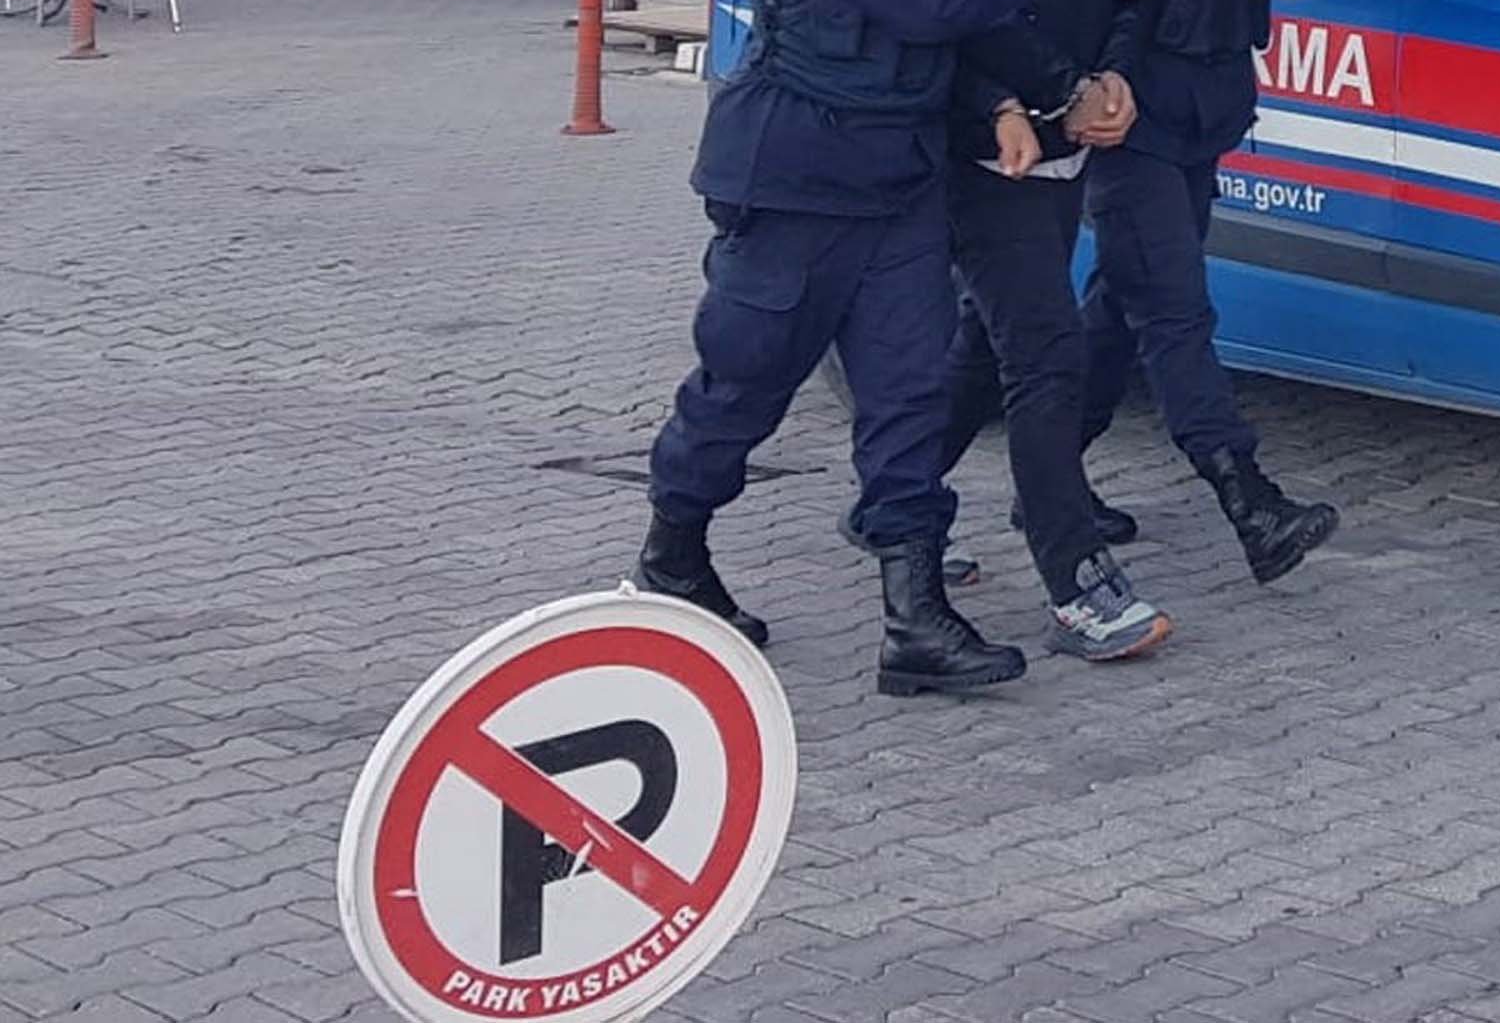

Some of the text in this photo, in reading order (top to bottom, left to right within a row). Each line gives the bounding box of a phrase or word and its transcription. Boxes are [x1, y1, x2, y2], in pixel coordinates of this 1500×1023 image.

[500, 719, 678, 965] P
[443, 905, 700, 1012] PARK YASAKTIR
